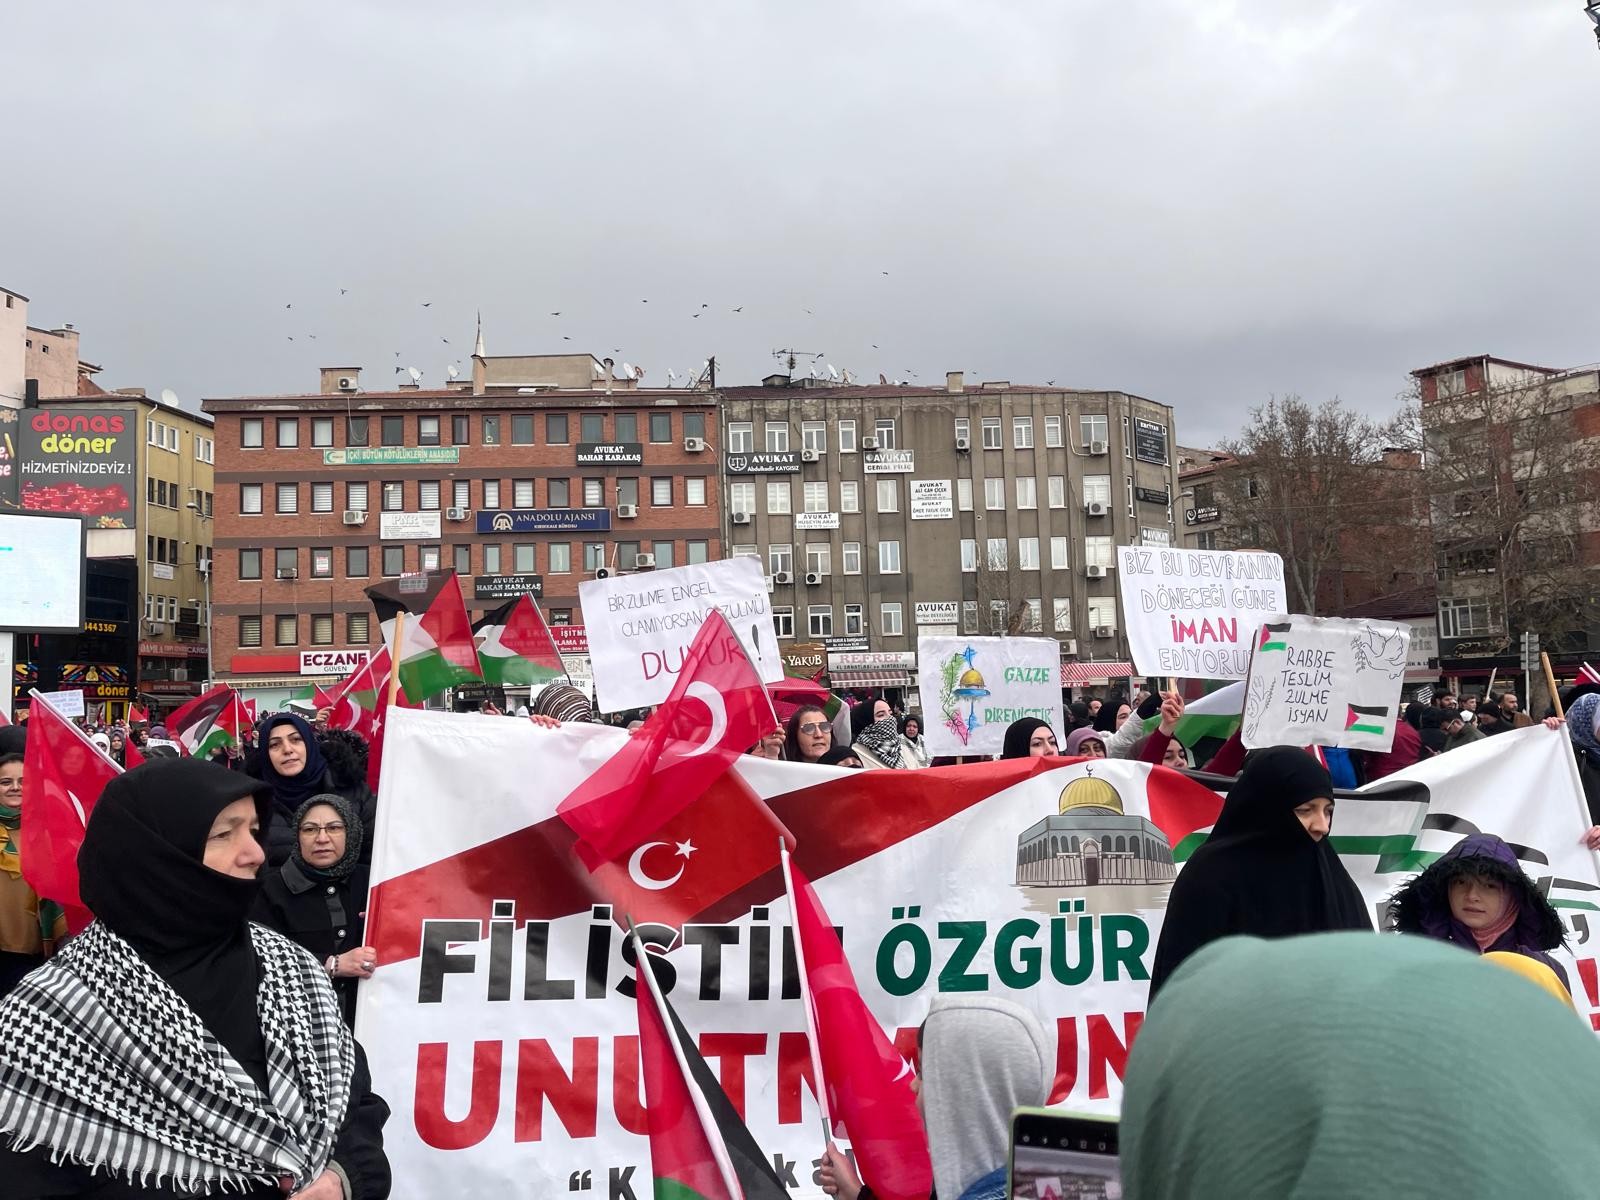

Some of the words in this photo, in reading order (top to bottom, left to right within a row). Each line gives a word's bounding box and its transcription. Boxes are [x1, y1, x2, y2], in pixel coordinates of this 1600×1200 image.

[32, 411, 125, 433] donas
[41, 434, 117, 453] döner
[594, 446, 624, 454] AVUKAT
[21, 460, 125, 474] HİZMETİNİZDEYİZ
[604, 454, 641, 463] KARAKAŞ
[752, 455, 794, 463] AVUKAT
[874, 453, 911, 462] AVUKAT
[516, 513, 562, 522] ANADOLU
[563, 512, 596, 523] AJANSI
[1124, 547, 1153, 575] BİZ
[1160, 551, 1184, 576] BU
[1187, 554, 1281, 581] DEVRANIN
[504, 582, 542, 592] KARAKAŞ
[607, 593, 626, 612] BİR
[627, 589, 666, 609] ZULME
[671, 581, 717, 601] ENGEL
[916, 603, 957, 611] AVUKAT
[1140, 584, 1227, 613] DÖNECEĞİ
[1231, 585, 1277, 612] GÜNE
[621, 610, 703, 638] OLAMIYORSAN
[1170, 614, 1238, 645] İMAN
[751, 623, 762, 662] !
[787, 654, 823, 667] YAKUB
[1158, 646, 1252, 676] EDİYORU
[1286, 646, 1336, 669] RABBE
[1003, 666, 1050, 685] GAZZE
[1280, 669, 1333, 688] TESLİM
[97, 685, 129, 696] döner
[1284, 689, 1331, 706] ZULME
[1287, 706, 1328, 724] İSYAN
[875, 899, 1151, 997] ÖZGÜR
